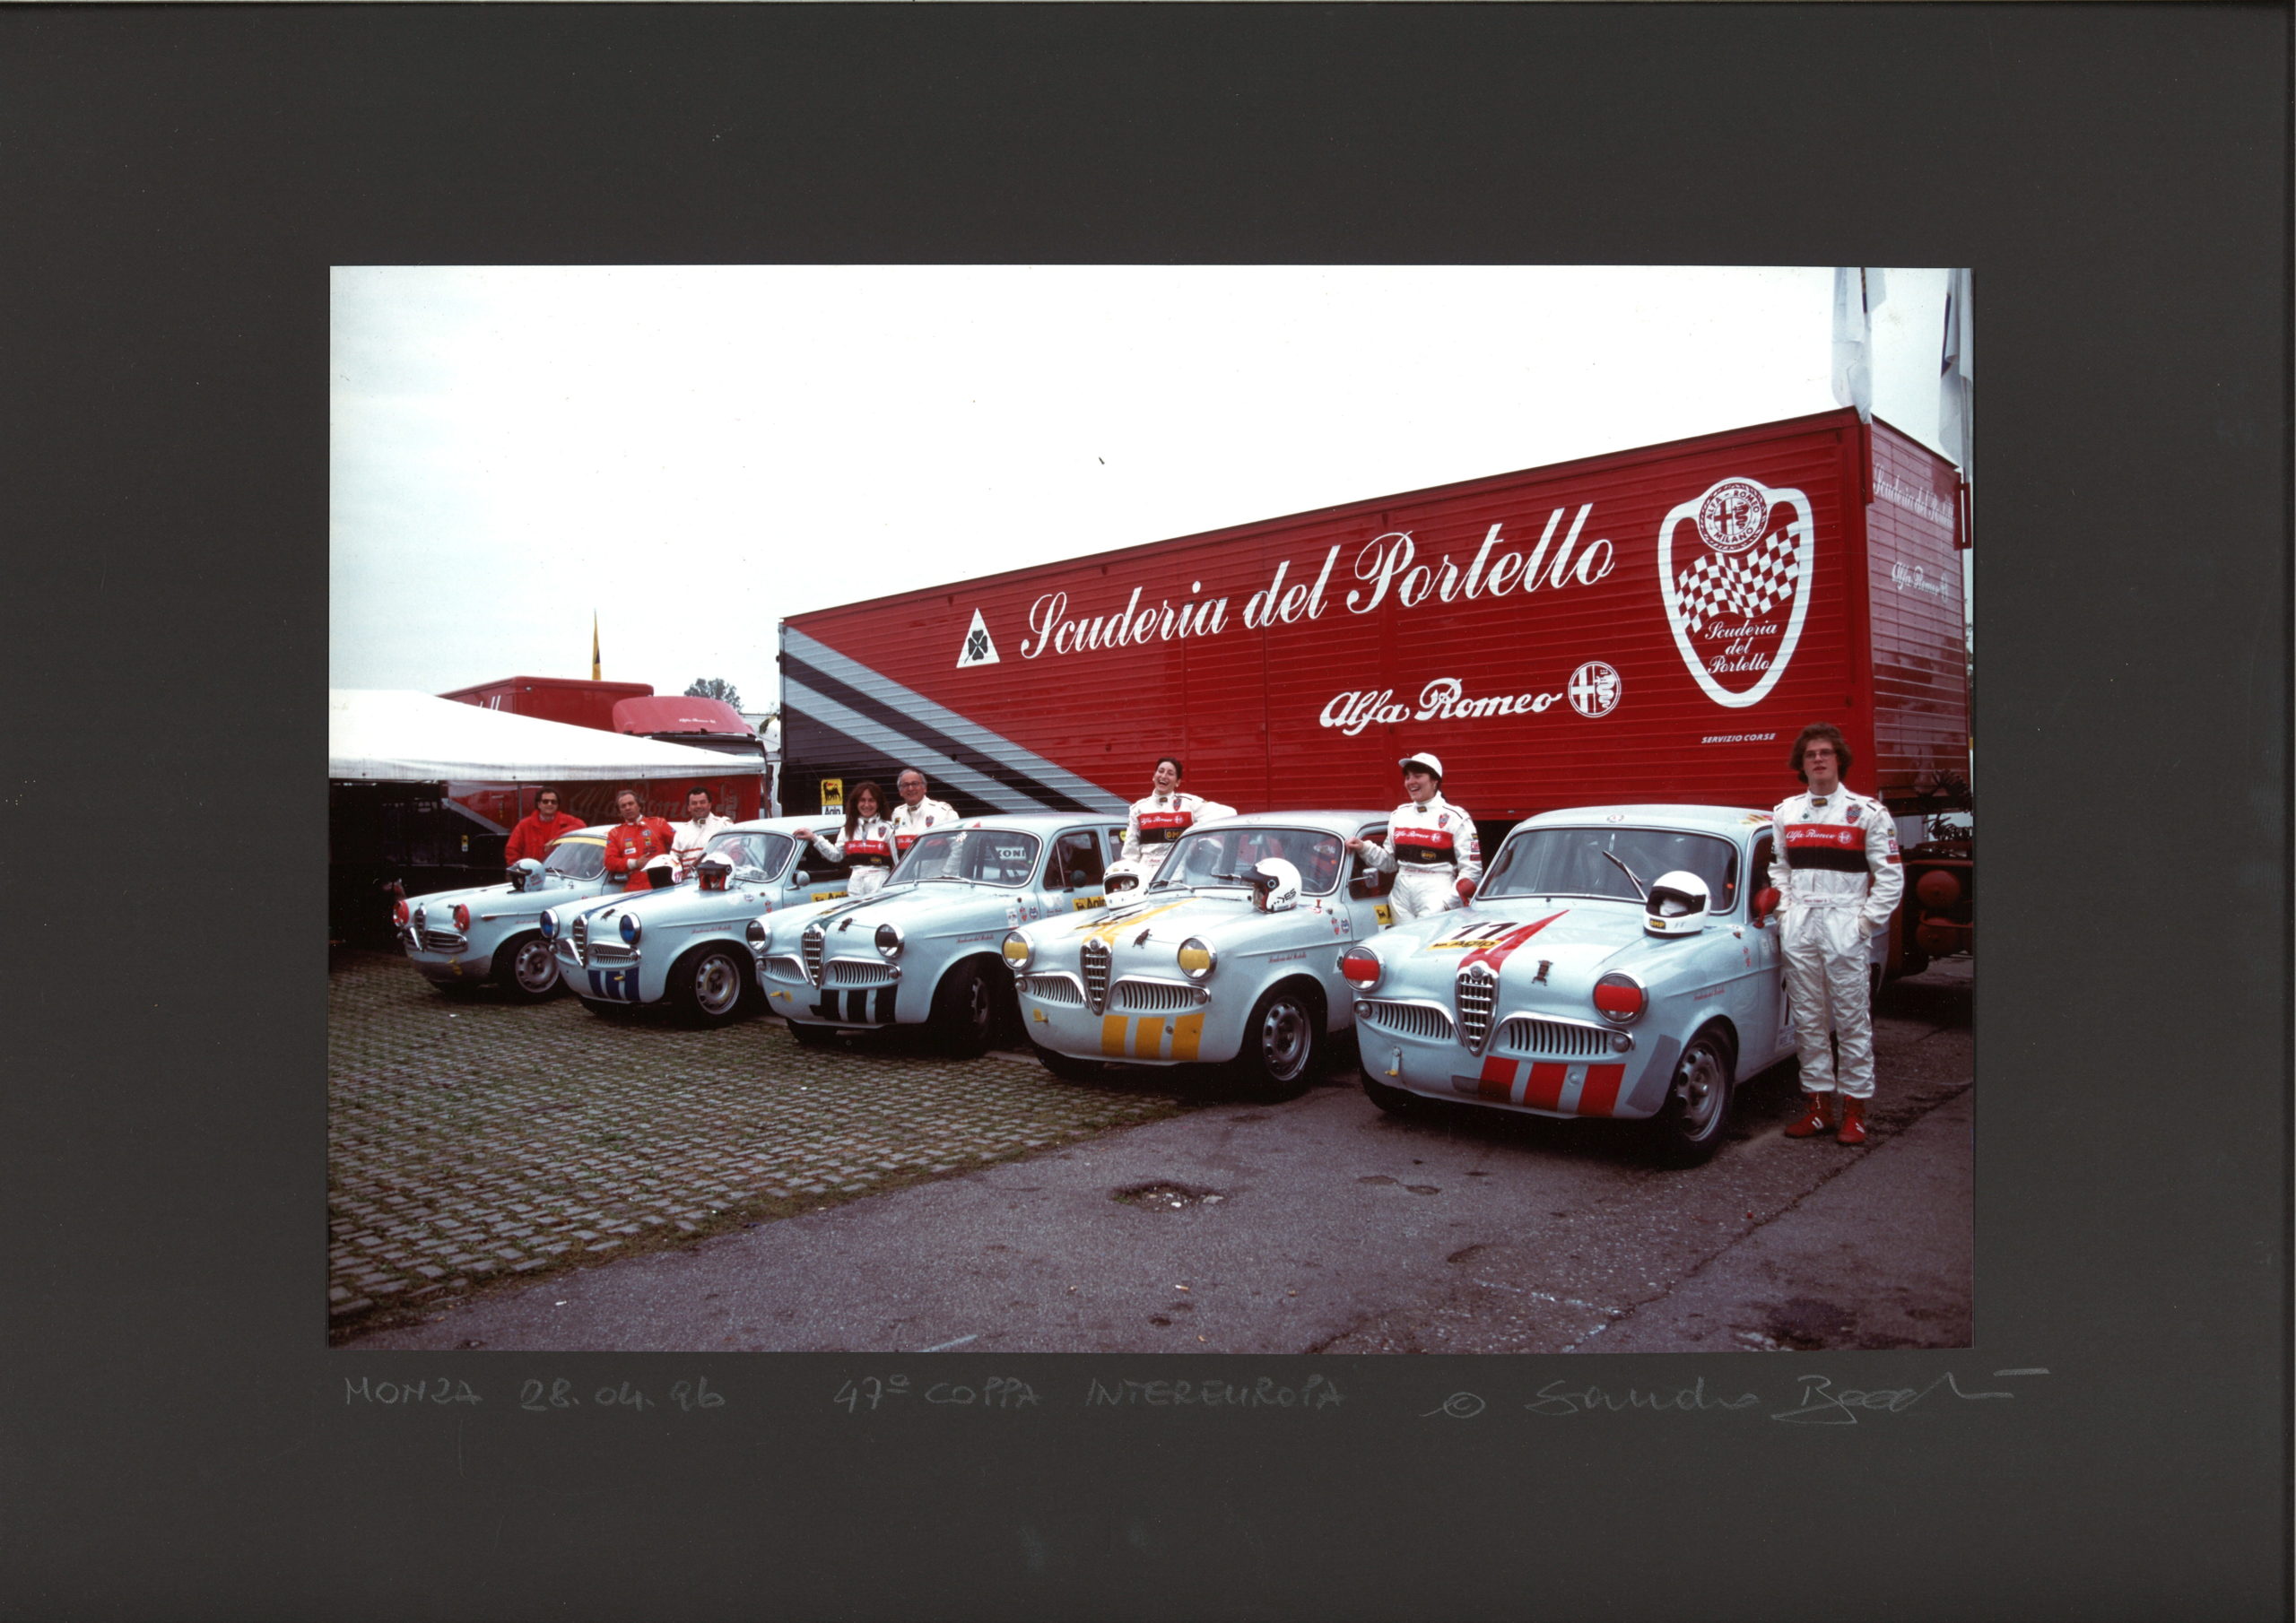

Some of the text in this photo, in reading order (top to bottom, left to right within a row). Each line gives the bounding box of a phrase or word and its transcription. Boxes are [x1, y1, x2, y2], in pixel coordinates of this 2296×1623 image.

[1733, 490, 1761, 513] ROMEO
[1713, 526, 1754, 543] MILANO
[1021, 502, 1616, 661] Scuderia del Portello
[1704, 617, 1779, 641] Scuderia
[1725, 636, 1752, 655] del
[1707, 654, 1770, 675] Portello
[1318, 677, 1563, 737] Alfa Romeo
[1700, 733, 1776, 744] SERVIZIO CORSE
[1450, 922, 1519, 940] 11
[925, 1377, 1042, 1407] COPPA
